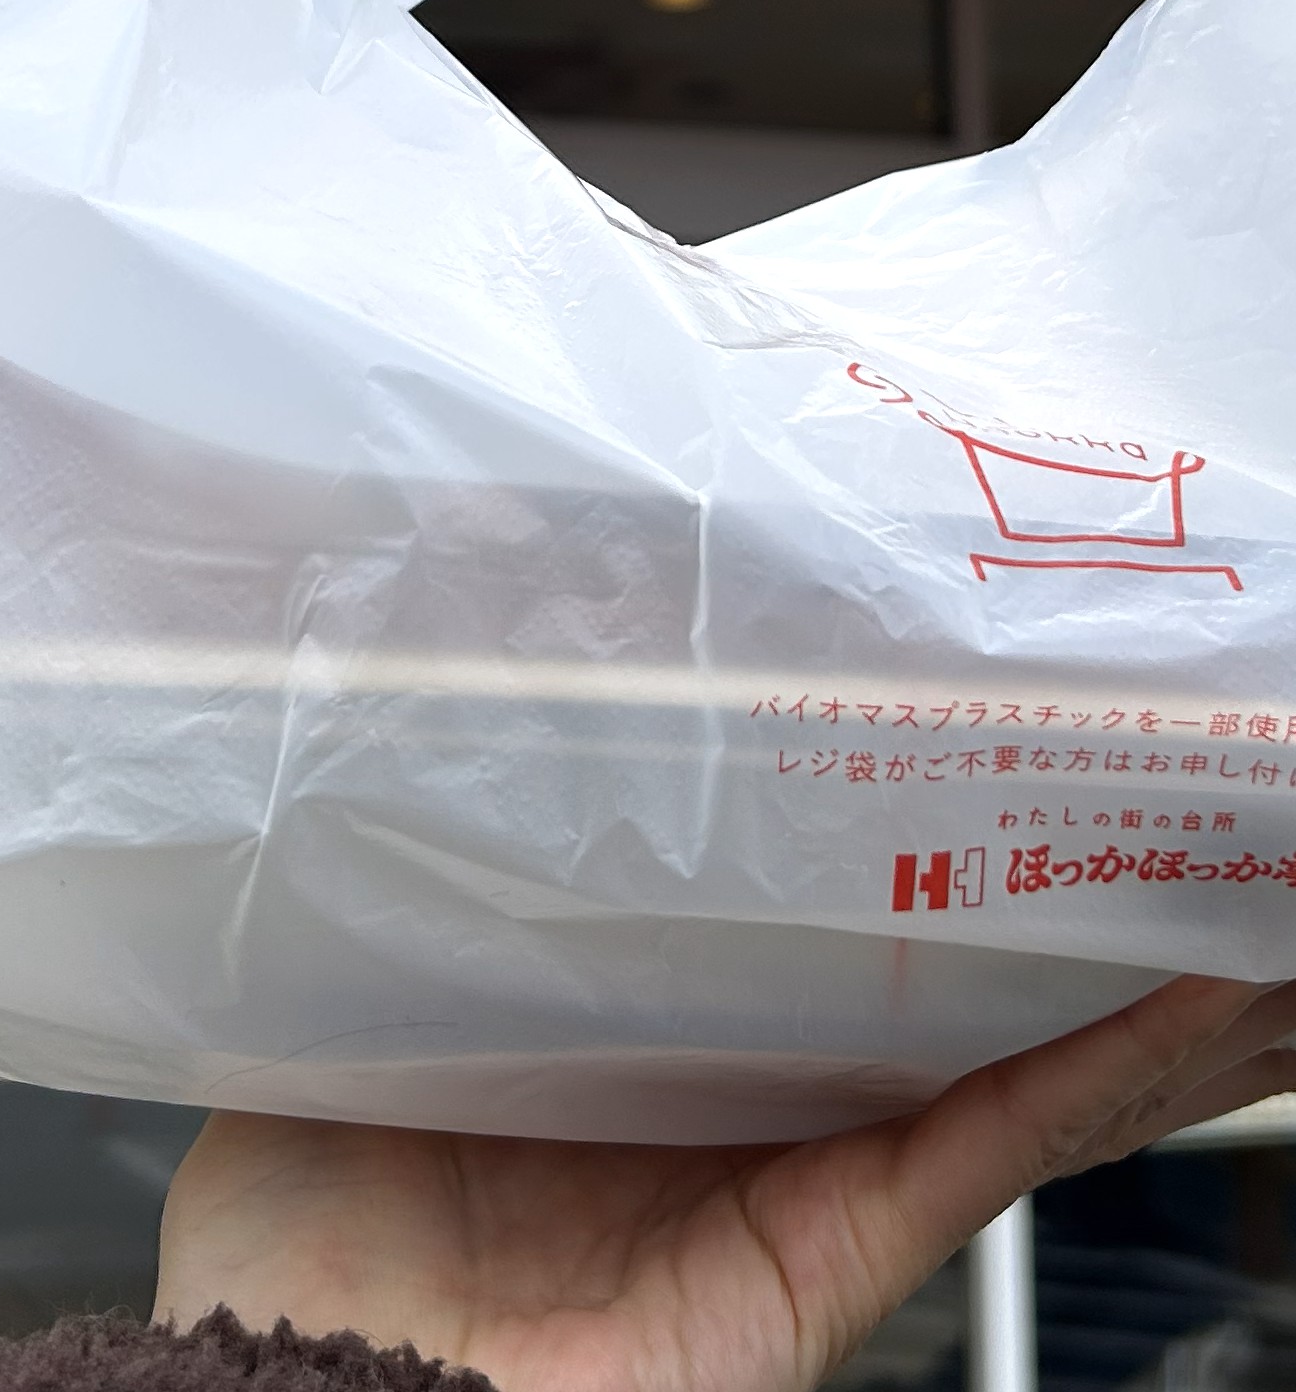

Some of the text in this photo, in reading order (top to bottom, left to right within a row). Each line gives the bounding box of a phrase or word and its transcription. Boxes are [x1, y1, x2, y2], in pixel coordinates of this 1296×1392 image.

[997, 806, 1237, 833] わたしの街の台所
